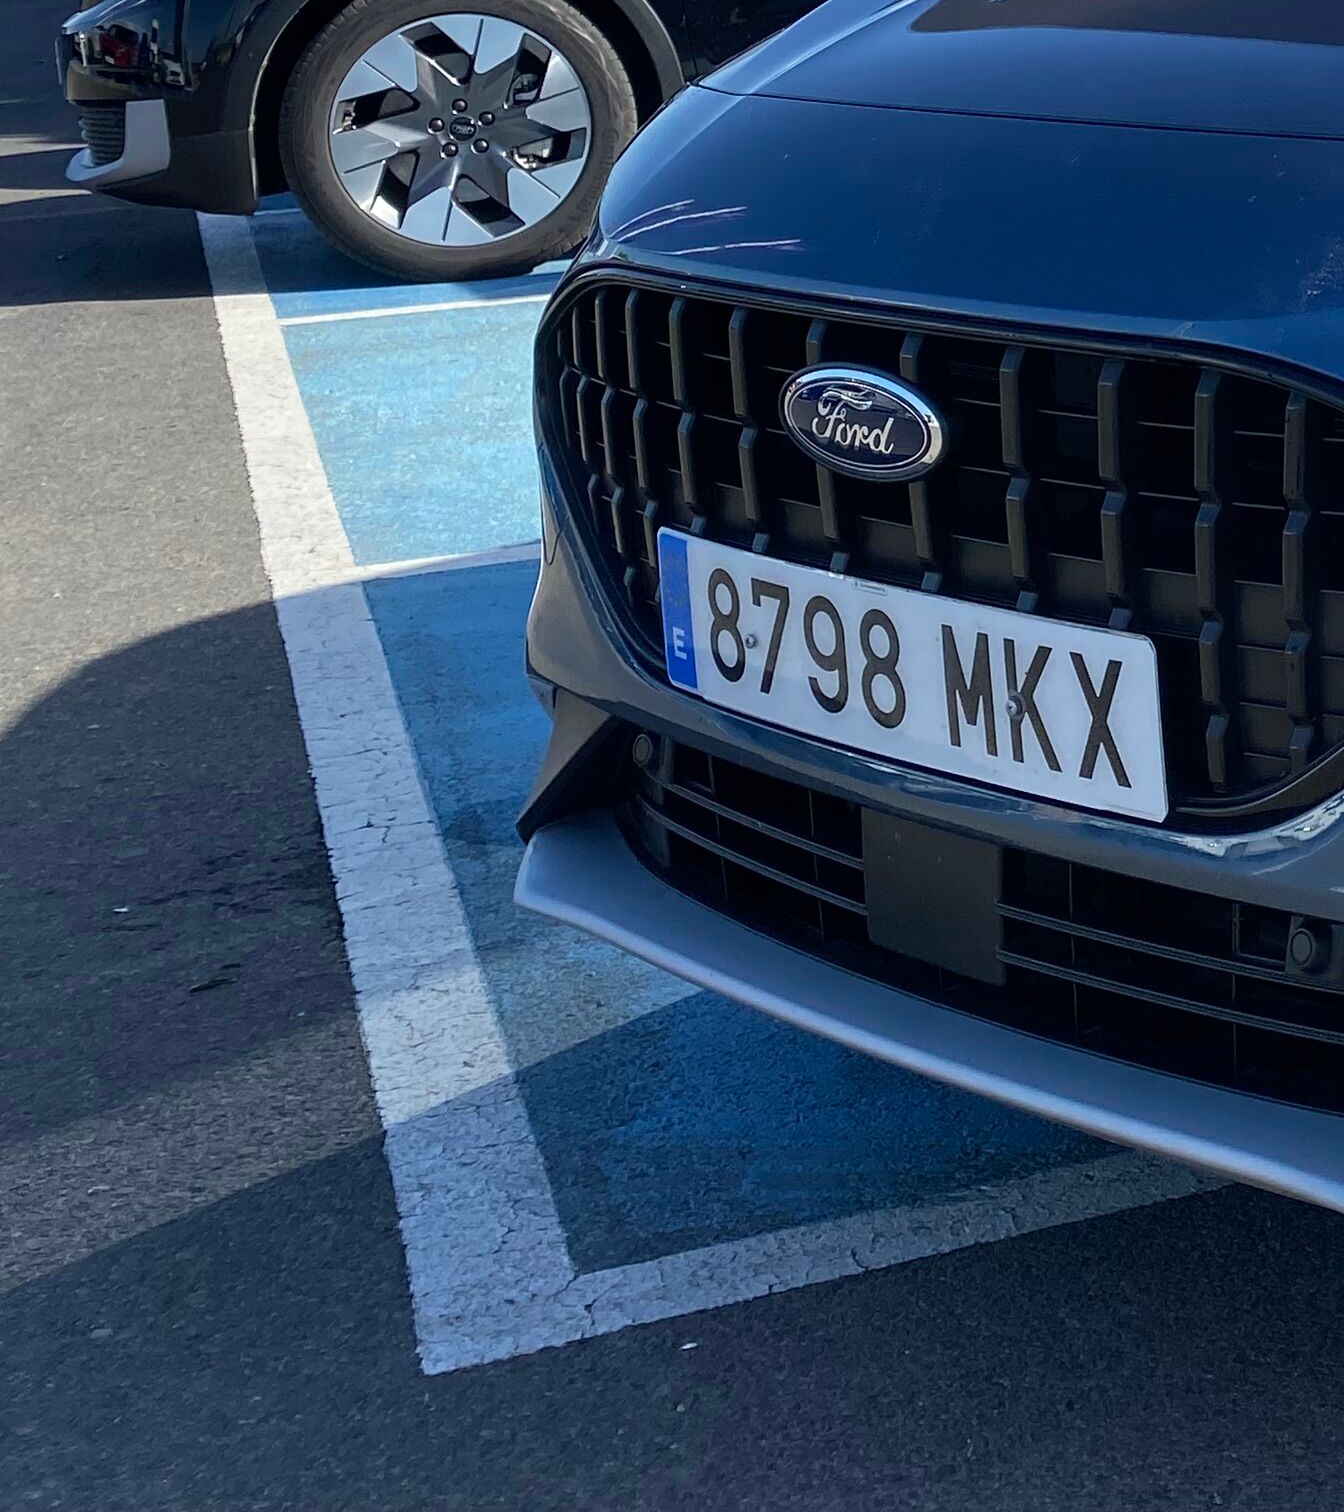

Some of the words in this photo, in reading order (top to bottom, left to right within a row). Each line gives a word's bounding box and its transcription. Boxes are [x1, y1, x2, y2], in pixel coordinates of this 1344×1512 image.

[811, 389, 894, 455] Ford
[672, 626, 688, 660] E
[707, 567, 907, 730] 8798
[941, 623, 1133, 789] MKX
